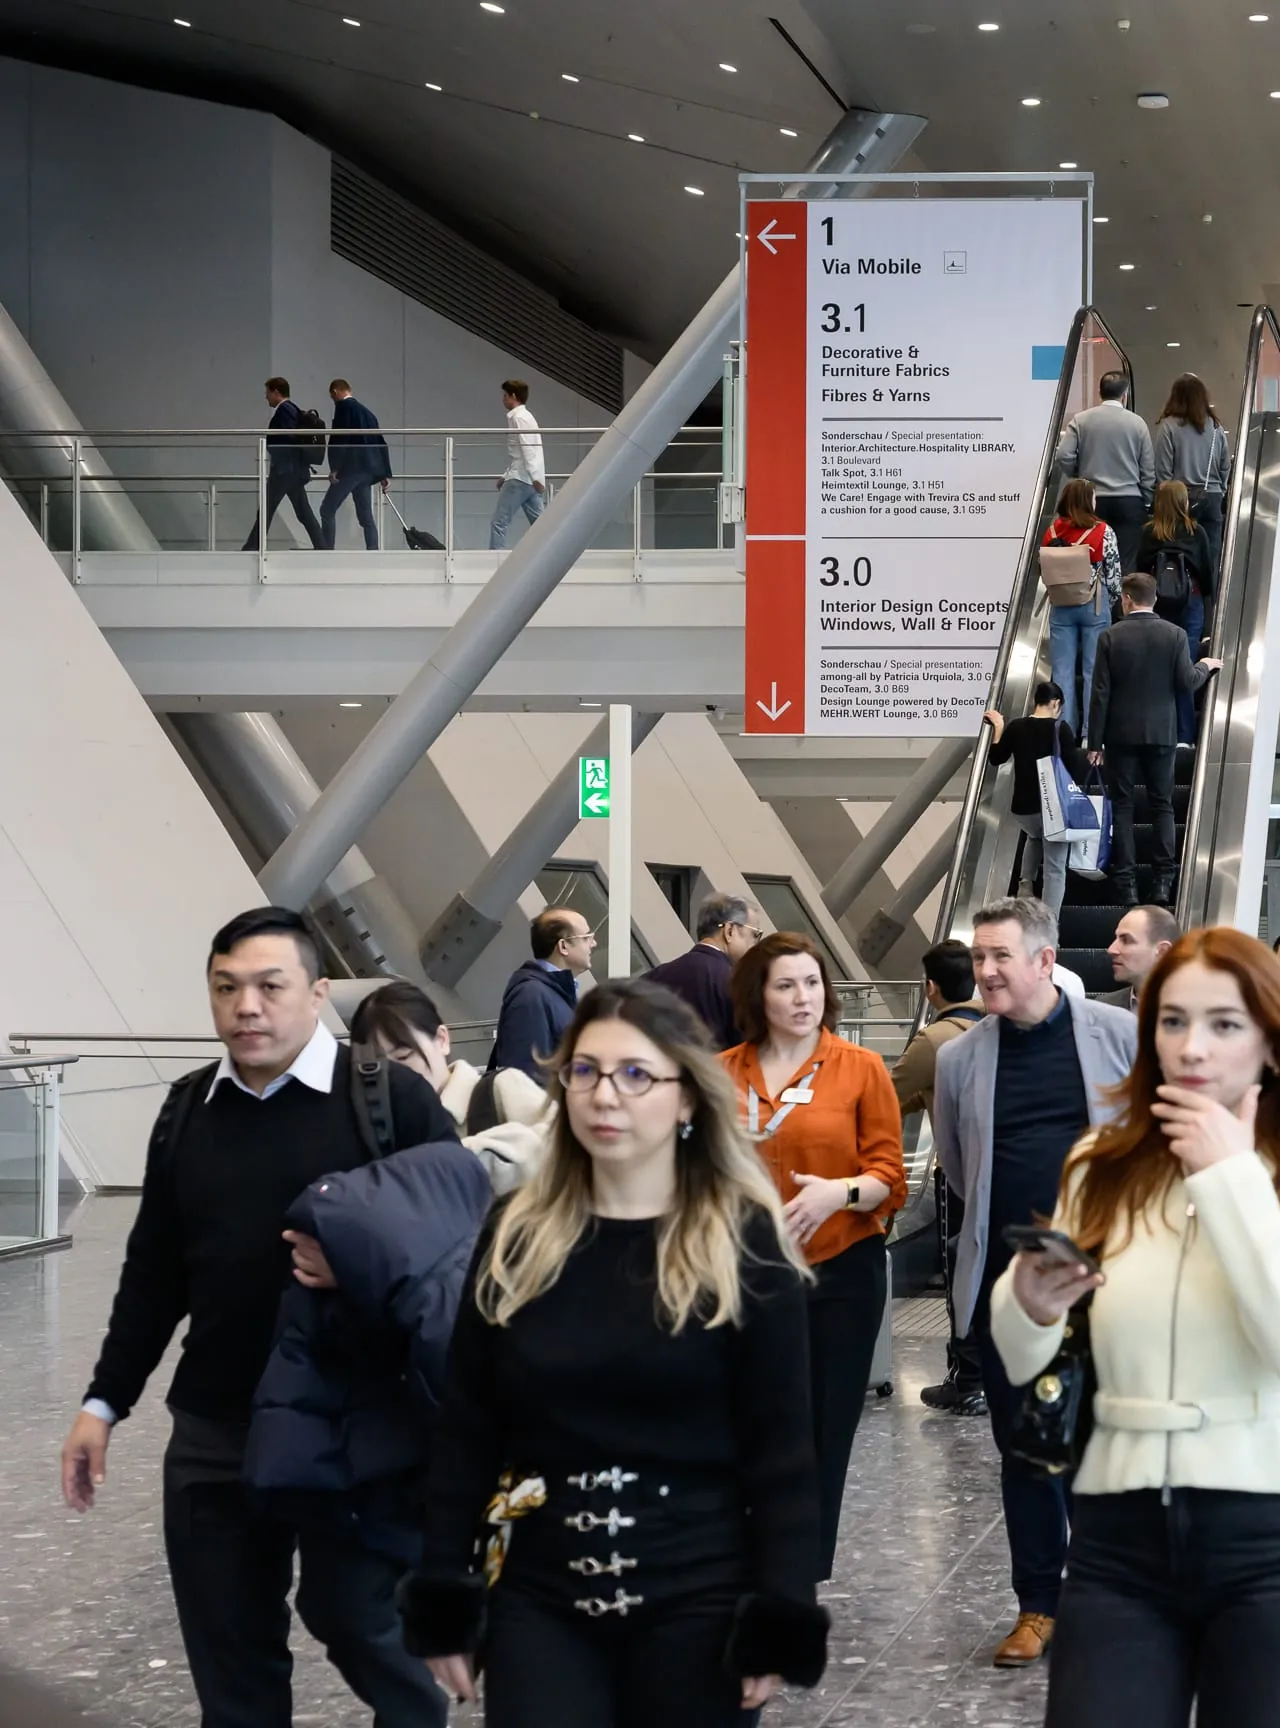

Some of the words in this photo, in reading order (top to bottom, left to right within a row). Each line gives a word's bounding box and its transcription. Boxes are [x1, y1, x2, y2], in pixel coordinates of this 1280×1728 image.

[821, 217, 833, 246] 1
[822, 258, 850, 274] Via
[858, 258, 921, 274] Mobile
[821, 303, 864, 333] 3.1
[822, 346, 902, 359] Decorative
[908, 345, 919, 358] &
[822, 364, 890, 376] Furniture
[896, 364, 949, 376] Fabrics
[822, 389, 867, 402] Fibres
[873, 389, 884, 401] &
[889, 389, 930, 401] Yarns
[822, 432, 882, 440] Sonderschau
[885, 431, 889, 439] /
[892, 431, 923, 441] Special
[926, 431, 983, 441] presentation:
[822, 444, 969, 453] Interior.Architecture.Hospitality
[973, 443, 1015, 453] LIBRARY,
[822, 456, 833, 464] 3.1
[837, 456, 880, 464] Boulevard
[821, 469, 840, 477] Talk
[843, 469, 866, 479] Spot,
[870, 468, 882, 477] 3.1
[886, 468, 901, 477] H61
[822, 481, 869, 489] Heimtextil
[873, 481, 909, 491] Lounge,
[913, 481, 924, 489] 3.1
[928, 481, 944, 489] H51
[821, 493, 836, 502] We
[840, 493, 863, 502] Care!
[867, 493, 901, 503] Engage
[904, 493, 925, 501] with
[928, 493, 959, 501] Trevira
[963, 493, 975, 501] CS
[978, 493, 995, 501] and
[999, 493, 1020, 502] stuff
[830, 506, 866, 514] cushion
[869, 506, 882, 514] for
[893, 505, 916, 516] good
[953, 505, 965, 514] 3.1
[969, 505, 986, 514] G95
[820, 557, 871, 586] 3.0
[821, 600, 876, 612] Interior
[882, 599, 933, 615] Design
[939, 599, 1009, 615] Concepts
[820, 617, 895, 632] Windows,
[901, 617, 935, 630] Wall
[941, 617, 952, 630] &
[958, 618, 996, 631] Floor
[820, 660, 881, 668] Sonderschau
[884, 660, 888, 668] /
[891, 660, 922, 670] Special
[925, 660, 982, 670] presentation:
[820, 672, 866, 682] among-all
[870, 672, 881, 682] by
[884, 672, 919, 680] Patricia
[923, 672, 964, 683] Urquiola,
[968, 672, 982, 681] 3.0
[985, 672, 994, 681] G
[821, 685, 871, 693] DecoTeam,
[875, 685, 888, 693] 3.0
[892, 685, 909, 693] B69
[821, 697, 852, 707] Design
[856, 697, 890, 707] Lounge
[893, 697, 933, 707] powered
[937, 697, 948, 707] by
[951, 697, 987, 706] DecoTe
[820, 709, 880, 718] MEHR.WERT
[884, 710, 920, 720] Lounge,
[924, 709, 937, 718] 3.0
[941, 710, 958, 719] B69
